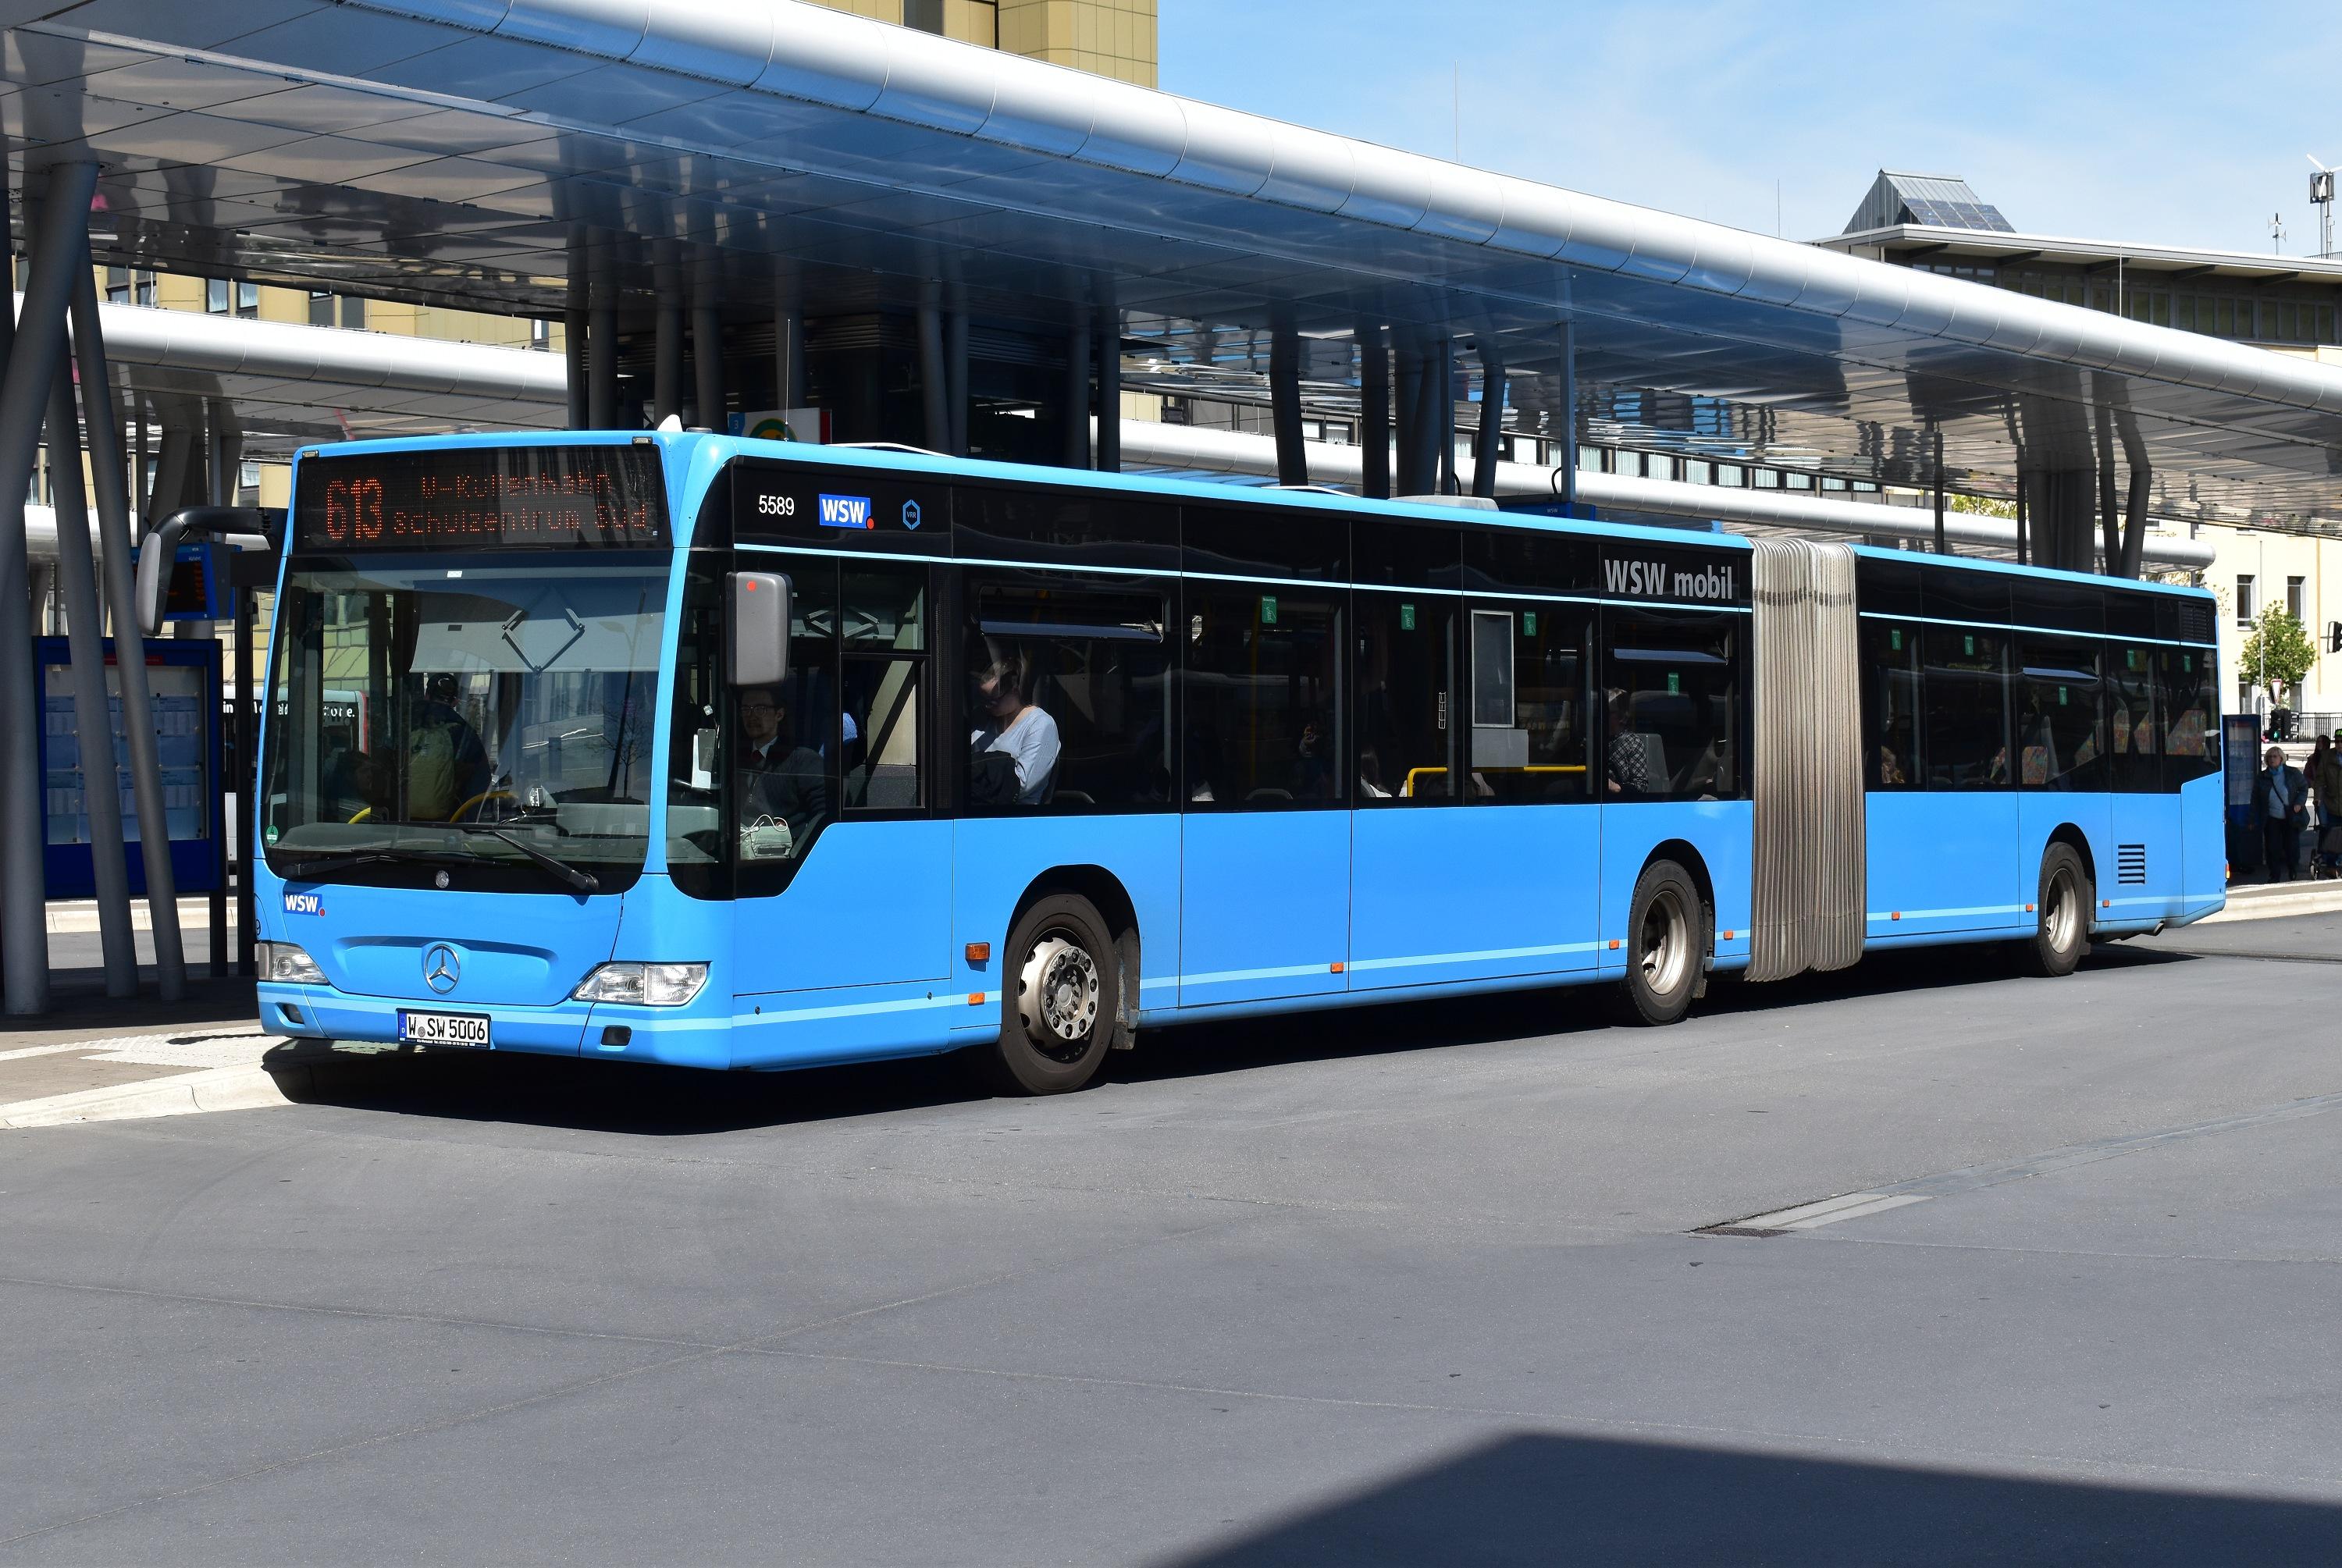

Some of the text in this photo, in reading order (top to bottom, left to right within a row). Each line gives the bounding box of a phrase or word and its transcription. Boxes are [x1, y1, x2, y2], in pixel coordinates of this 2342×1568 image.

[734, 420, 739, 428] 3
[326, 478, 383, 539] 613
[758, 494, 795, 516] 5589
[1604, 559, 1732, 599] WSW mobil
[408, 1016, 417, 1036] W
[427, 1018, 446, 1038] SW
[449, 1019, 486, 1040] 5006
